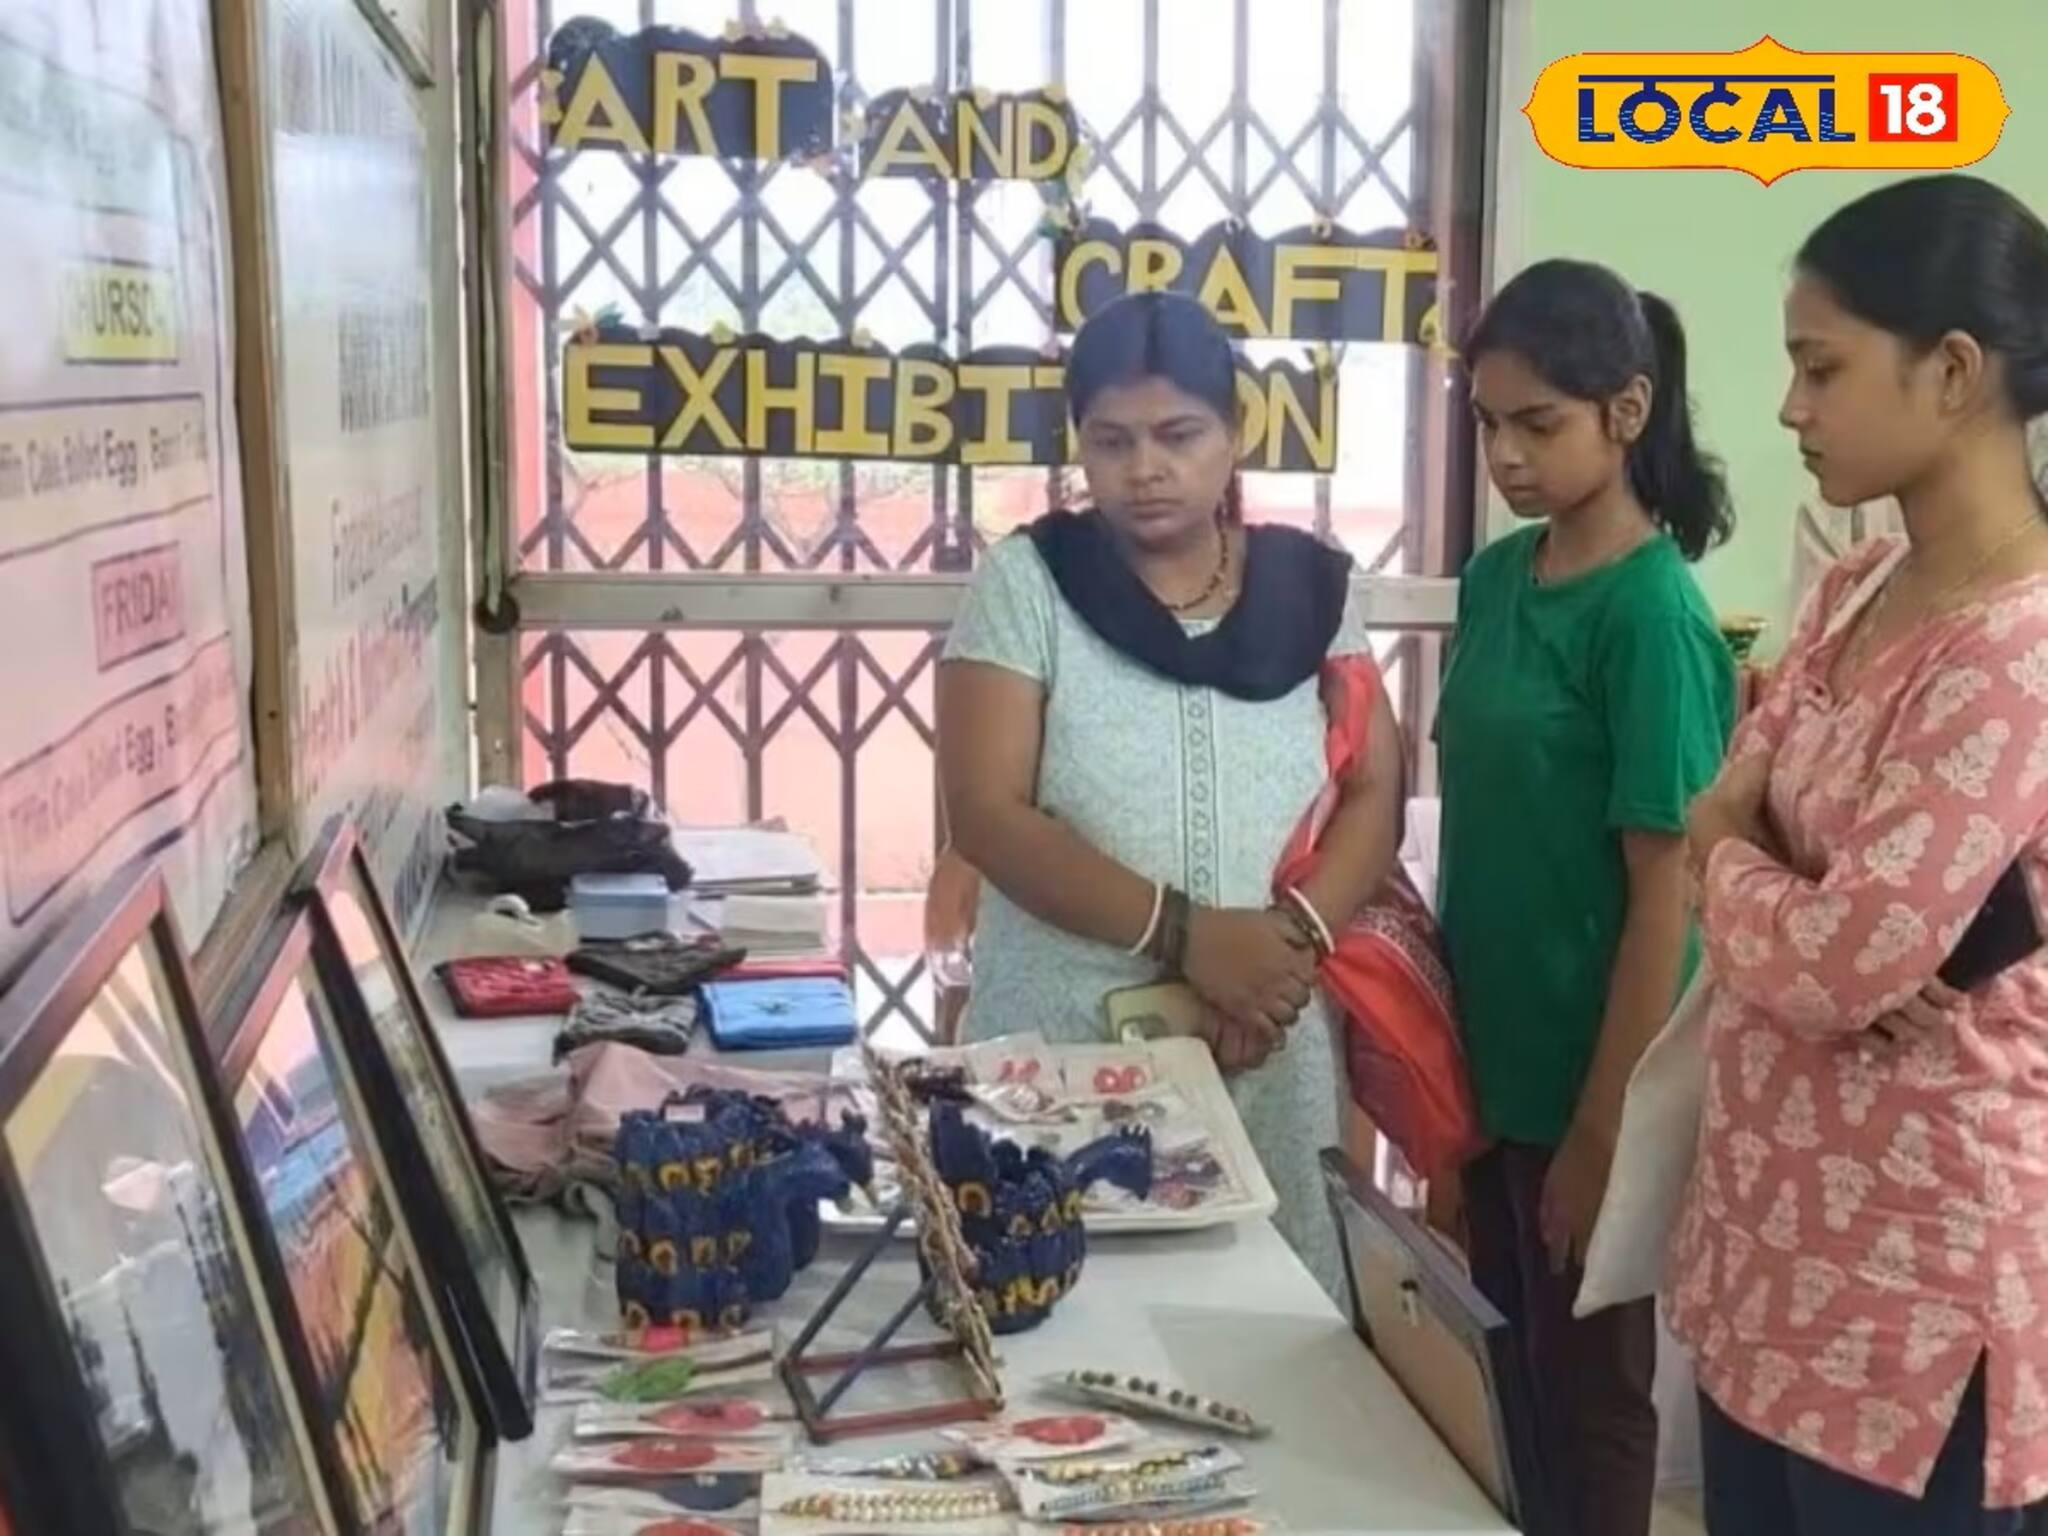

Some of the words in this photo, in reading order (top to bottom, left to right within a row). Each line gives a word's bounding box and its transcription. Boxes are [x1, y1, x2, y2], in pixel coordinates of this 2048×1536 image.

[553, 51, 818, 161] ART
[863, 99, 1068, 179] AND
[1060, 239, 1437, 342] CRAFT
[564, 344, 1334, 468] EXHIBIN
